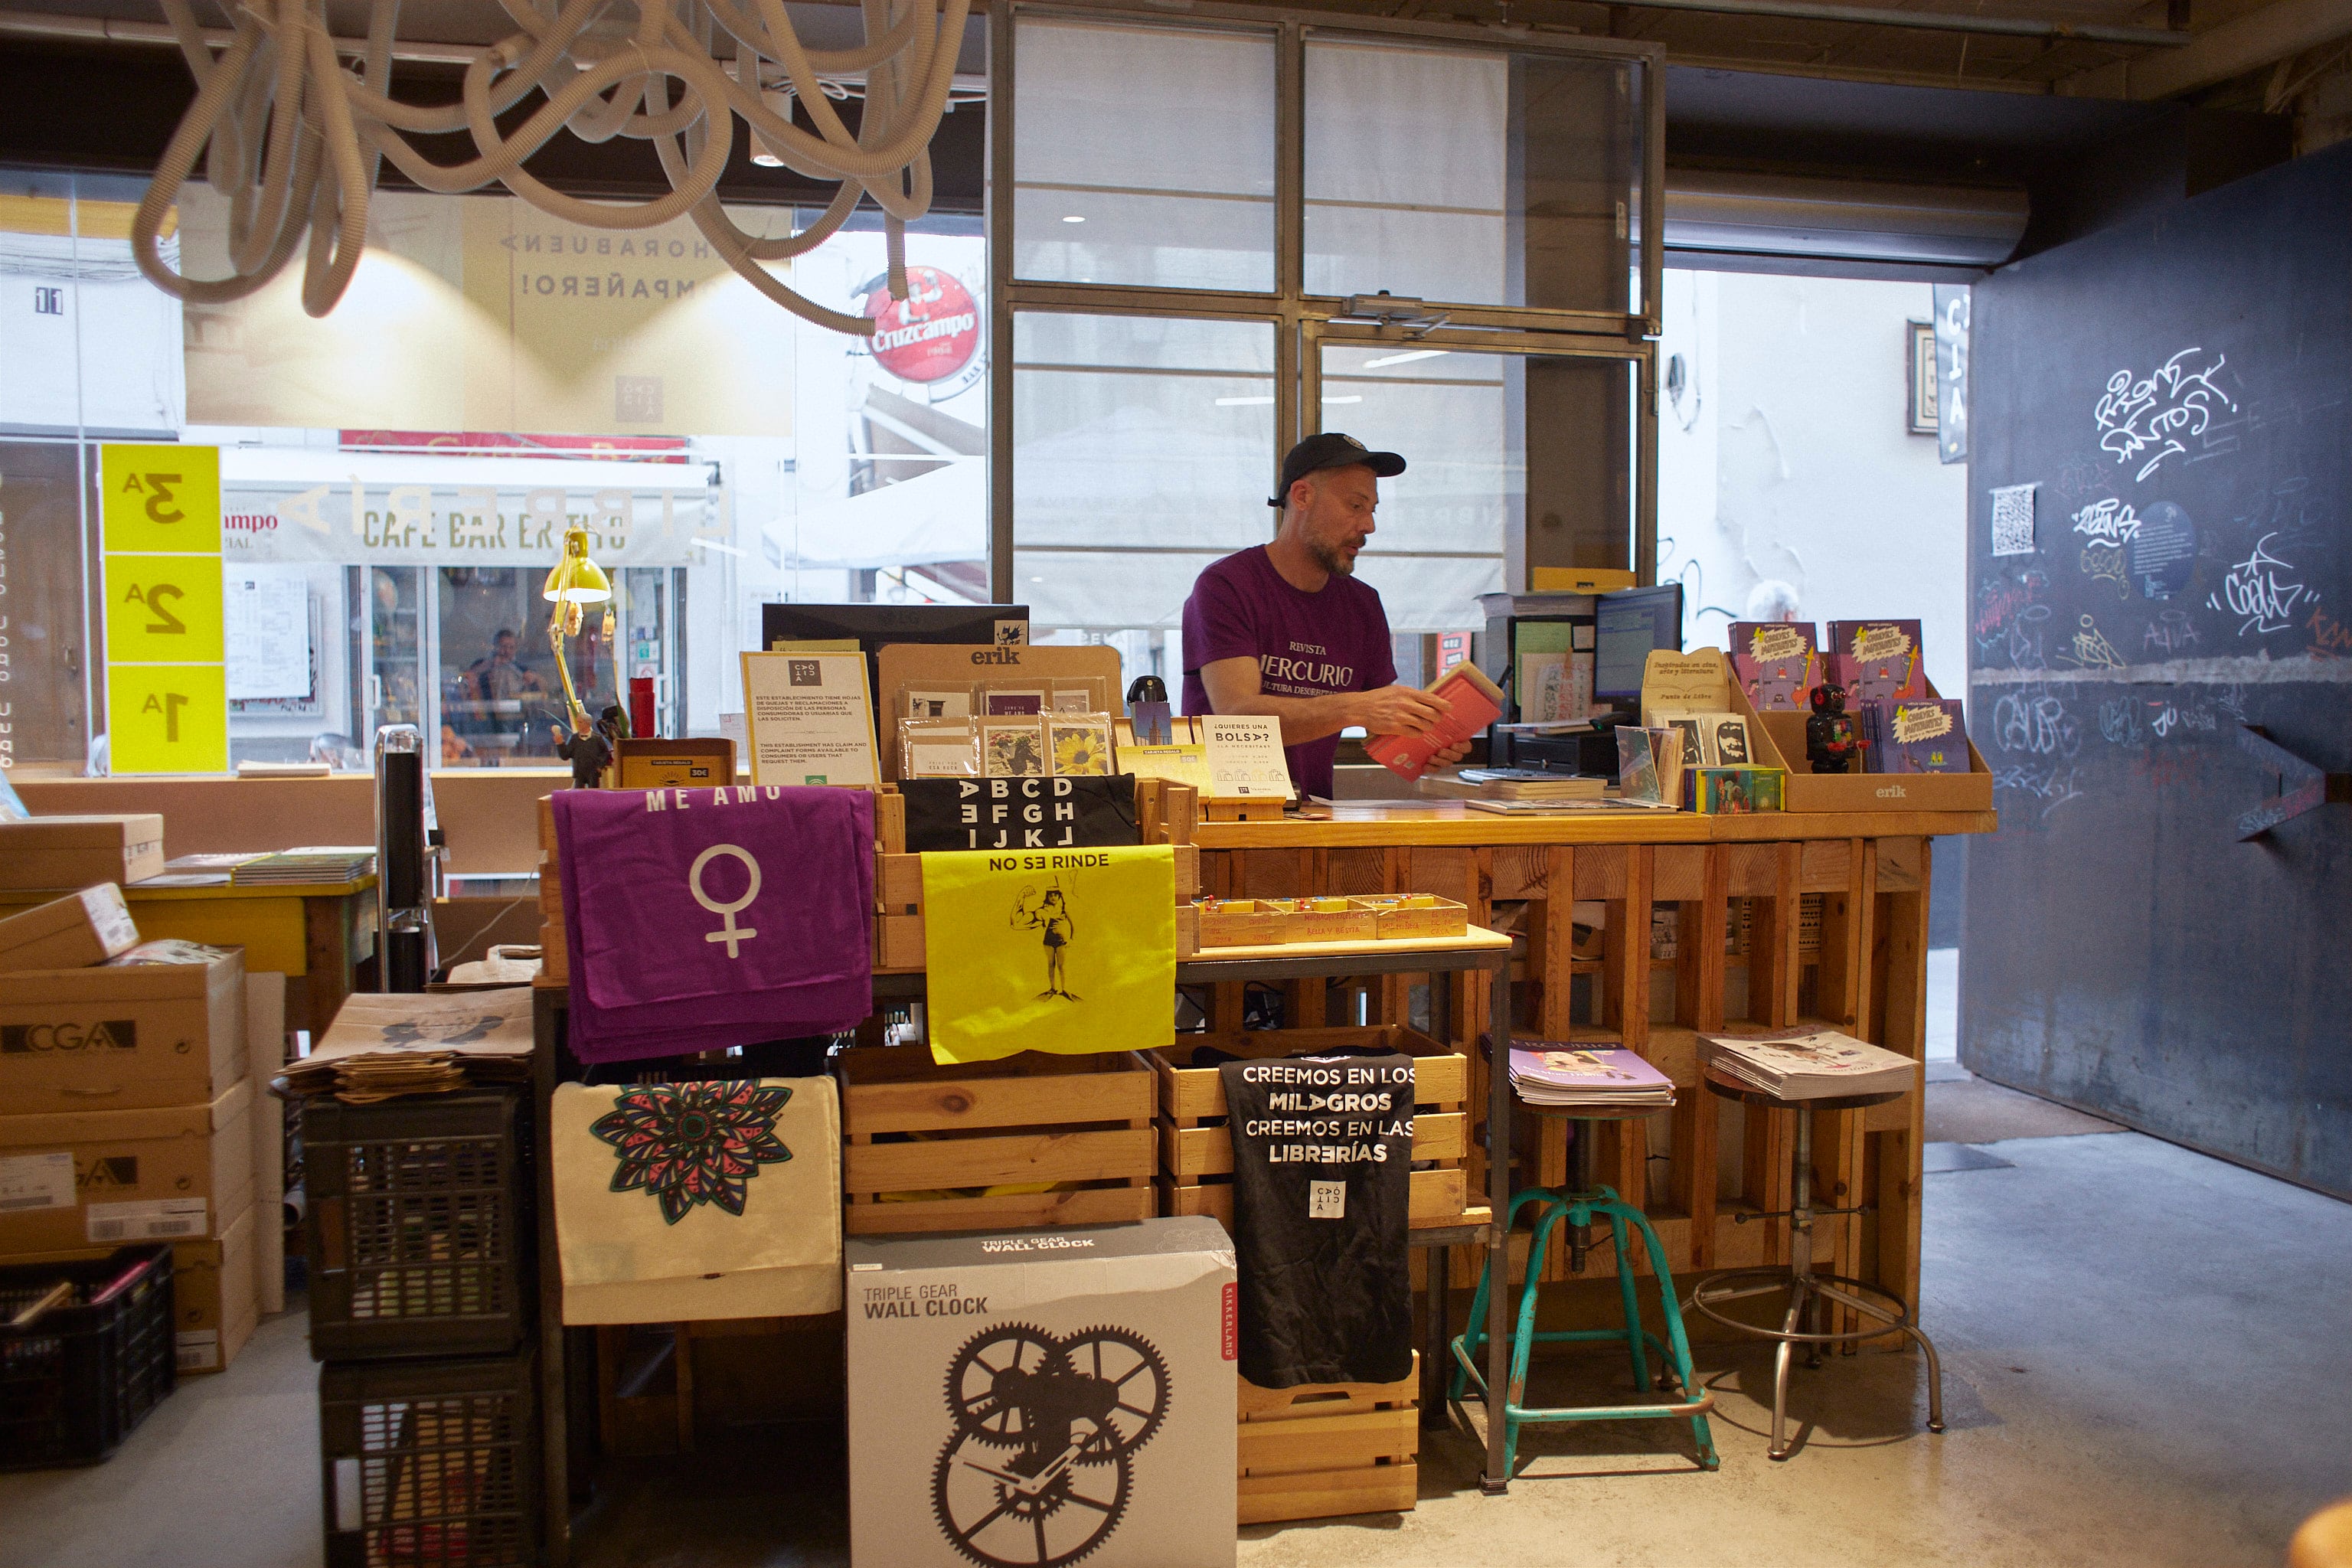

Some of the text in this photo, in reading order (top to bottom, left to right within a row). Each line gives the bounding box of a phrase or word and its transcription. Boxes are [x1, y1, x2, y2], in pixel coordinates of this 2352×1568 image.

[872, 312, 975, 353] Cruzcampo
[449, 511, 506, 549] BAR
[1753, 627, 1765, 643] 4
[1855, 626, 1867, 642] 4
[971, 647, 1021, 665] erik
[1289, 642, 1327, 655] REVISTA
[1896, 705, 1908, 722] 4
[991, 779, 1009, 798] B
[1022, 779, 1041, 798] C
[1054, 778, 1073, 796] D
[1876, 785, 1906, 798] erik
[646, 789, 690, 812] ME
[992, 804, 1008, 824] F
[1023, 803, 1043, 823] G
[1055, 802, 1074, 821] H
[993, 829, 1008, 848] J
[1024, 828, 1044, 848] K
[989, 858, 1017, 871] NO
[1053, 854, 1109, 869] RINDE
[26, 1022, 119, 1052] CGA
[1243, 1067, 1341, 1085] CREEMOS
[1348, 1068, 1374, 1084] EN
[1269, 1093, 1392, 1112] MILAGROS
[1246, 1120, 1341, 1136] CREEMOS
[1348, 1121, 1373, 1136] EN
[1269, 1141, 1387, 1163] LIBRERÍAS
[982, 1240, 1096, 1253] WALL CLOCK
[864, 1285, 958, 1302] TRIPLE GEAR
[864, 1297, 988, 1318] WALL CLOCK
